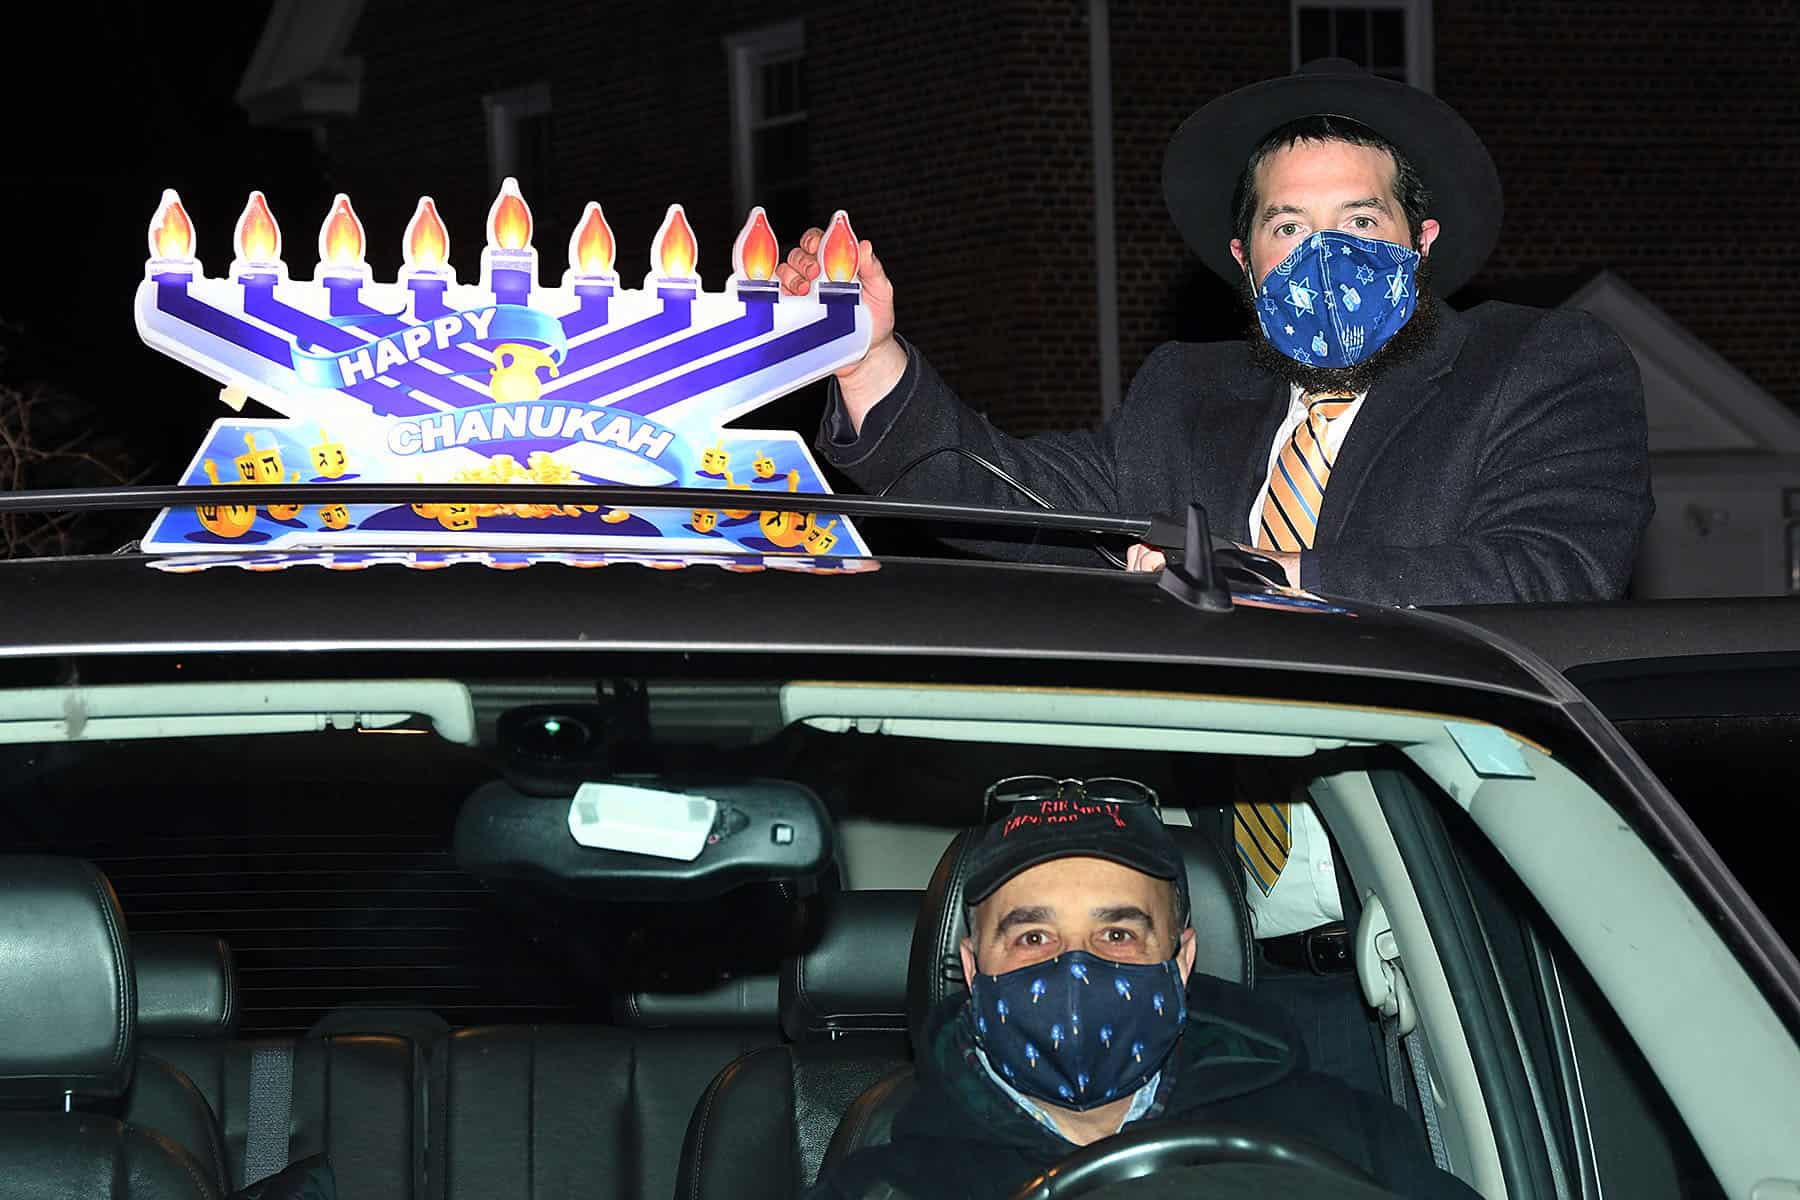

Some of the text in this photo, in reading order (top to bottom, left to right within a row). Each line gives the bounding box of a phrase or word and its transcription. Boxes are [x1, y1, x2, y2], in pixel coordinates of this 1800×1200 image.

[337, 307, 498, 387] HAPPY
[387, 405, 676, 460] CHANUKAH
[240, 461, 256, 480] ש
[262, 456, 279, 475] ה
